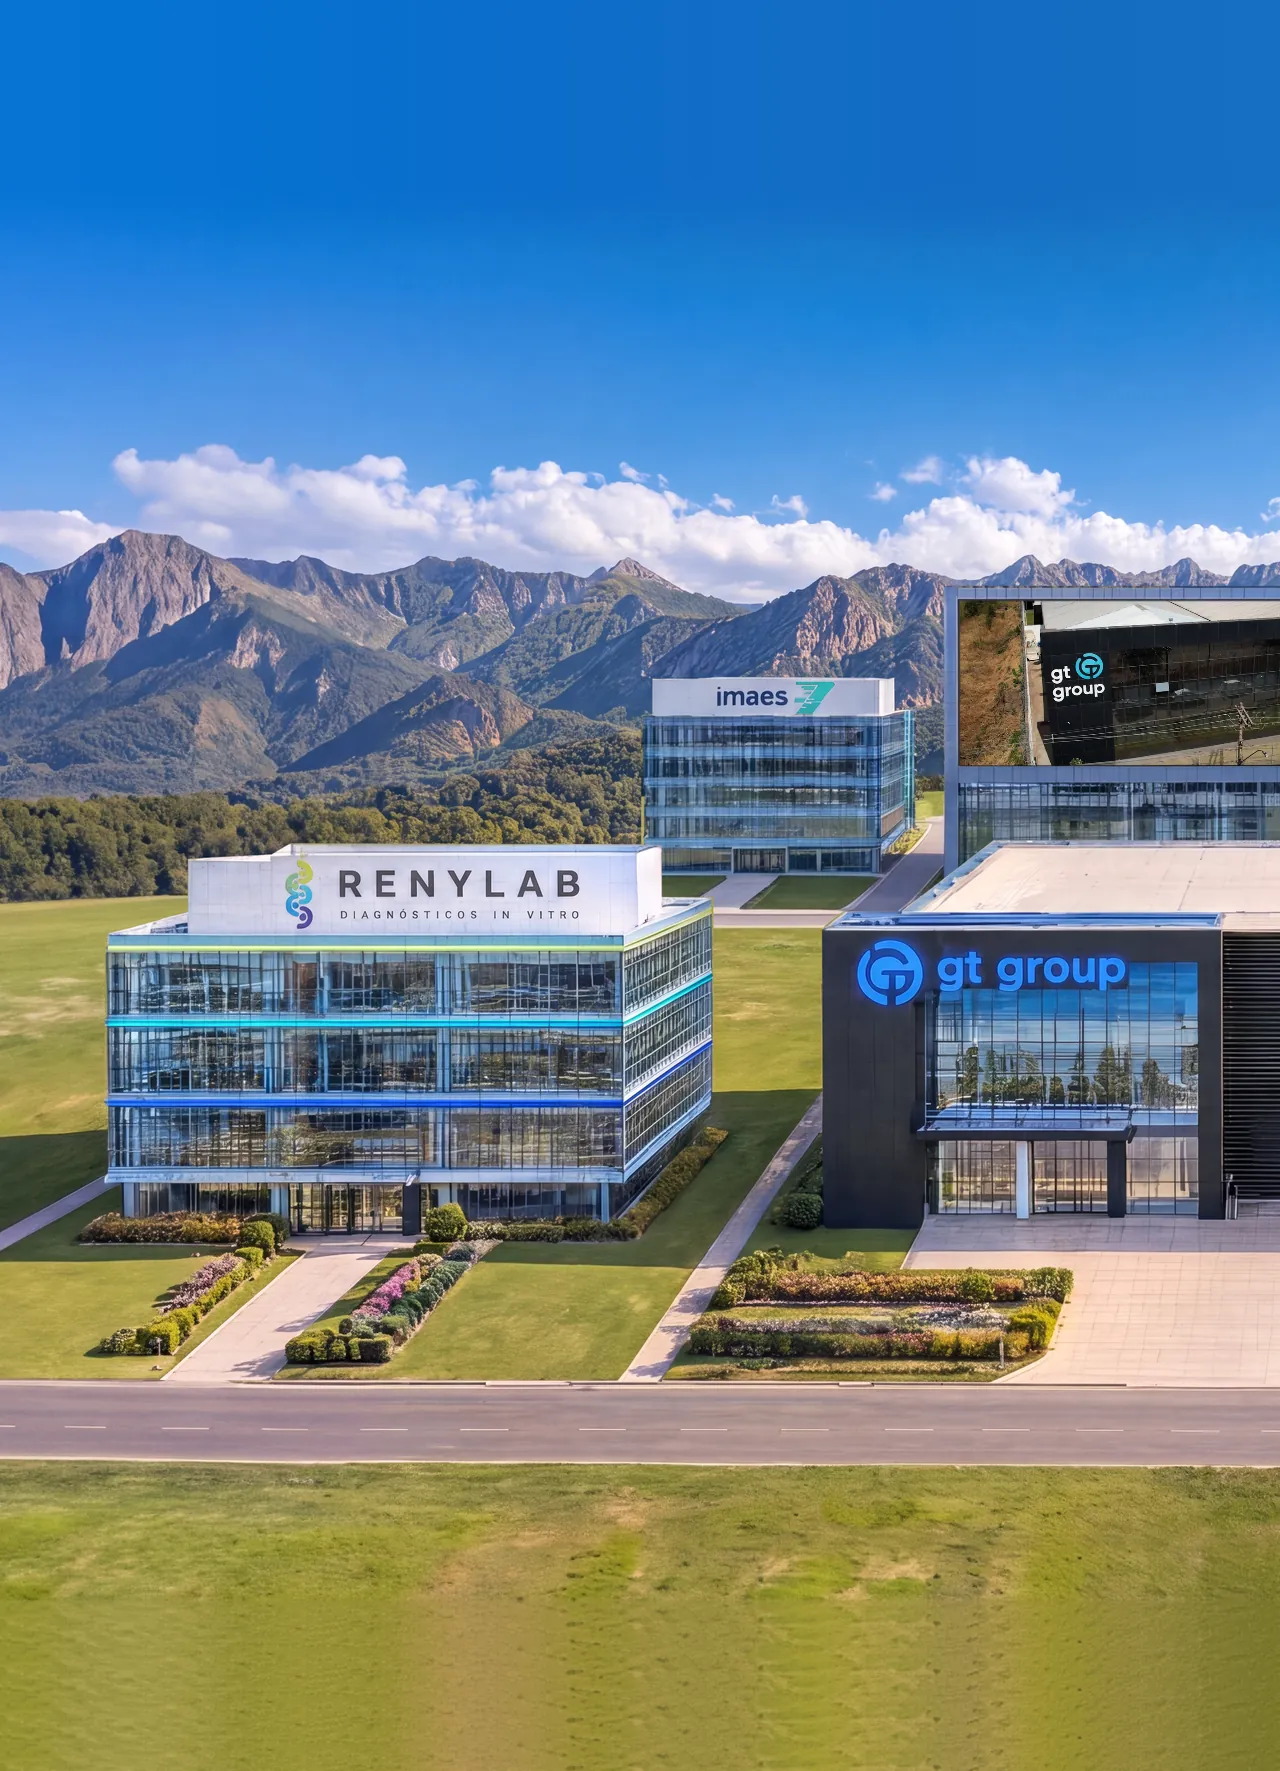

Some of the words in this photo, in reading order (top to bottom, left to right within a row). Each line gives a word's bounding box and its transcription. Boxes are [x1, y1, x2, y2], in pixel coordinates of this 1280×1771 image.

[1050, 665, 1071, 684] gt
[716, 686, 788, 706] imaes
[1052, 683, 1105, 702] group
[339, 870, 580, 898] RENYLAB
[340, 908, 477, 919] DIAGNÓSTICOS
[493, 910, 511, 919] IN
[527, 910, 580, 919] VITRO
[937, 951, 982, 992] gt
[997, 956, 1126, 991] group
